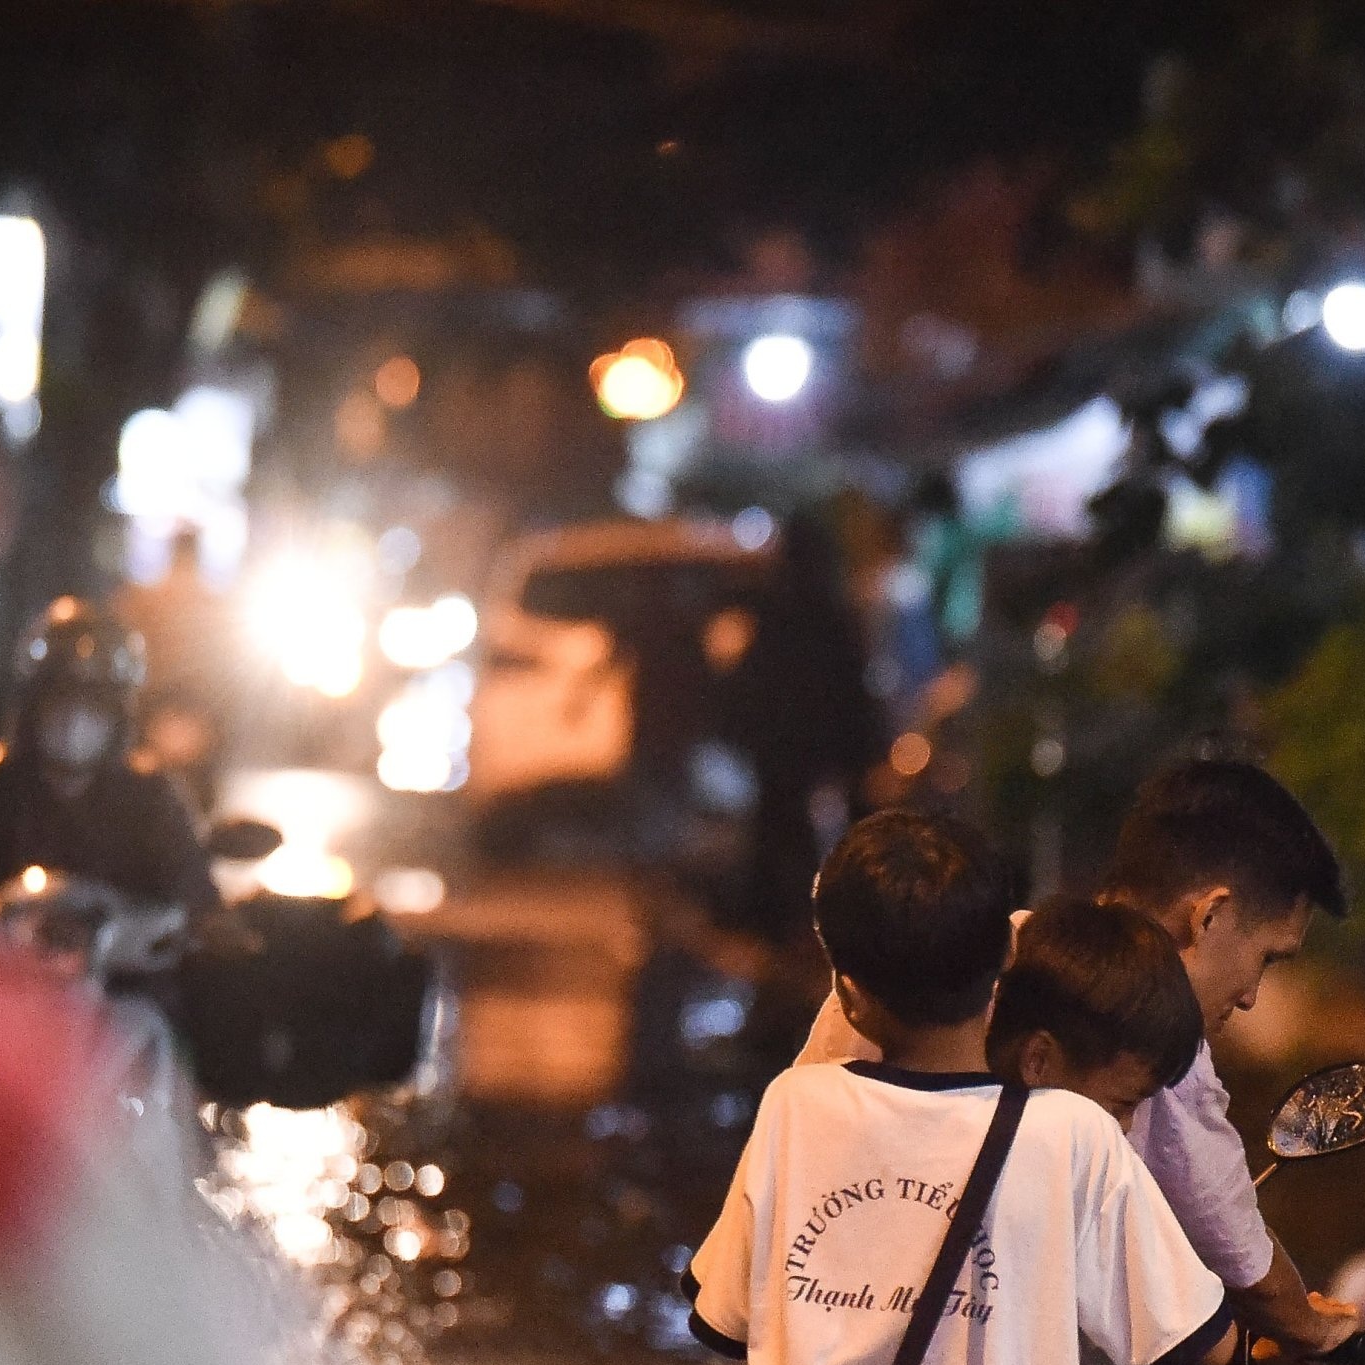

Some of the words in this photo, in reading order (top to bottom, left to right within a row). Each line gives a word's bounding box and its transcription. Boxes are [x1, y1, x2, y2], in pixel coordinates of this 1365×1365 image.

[785, 1178, 885, 1272] TRƯỜNG
[787, 1275, 875, 1313] Thạnh
[880, 1286, 915, 1314] M
